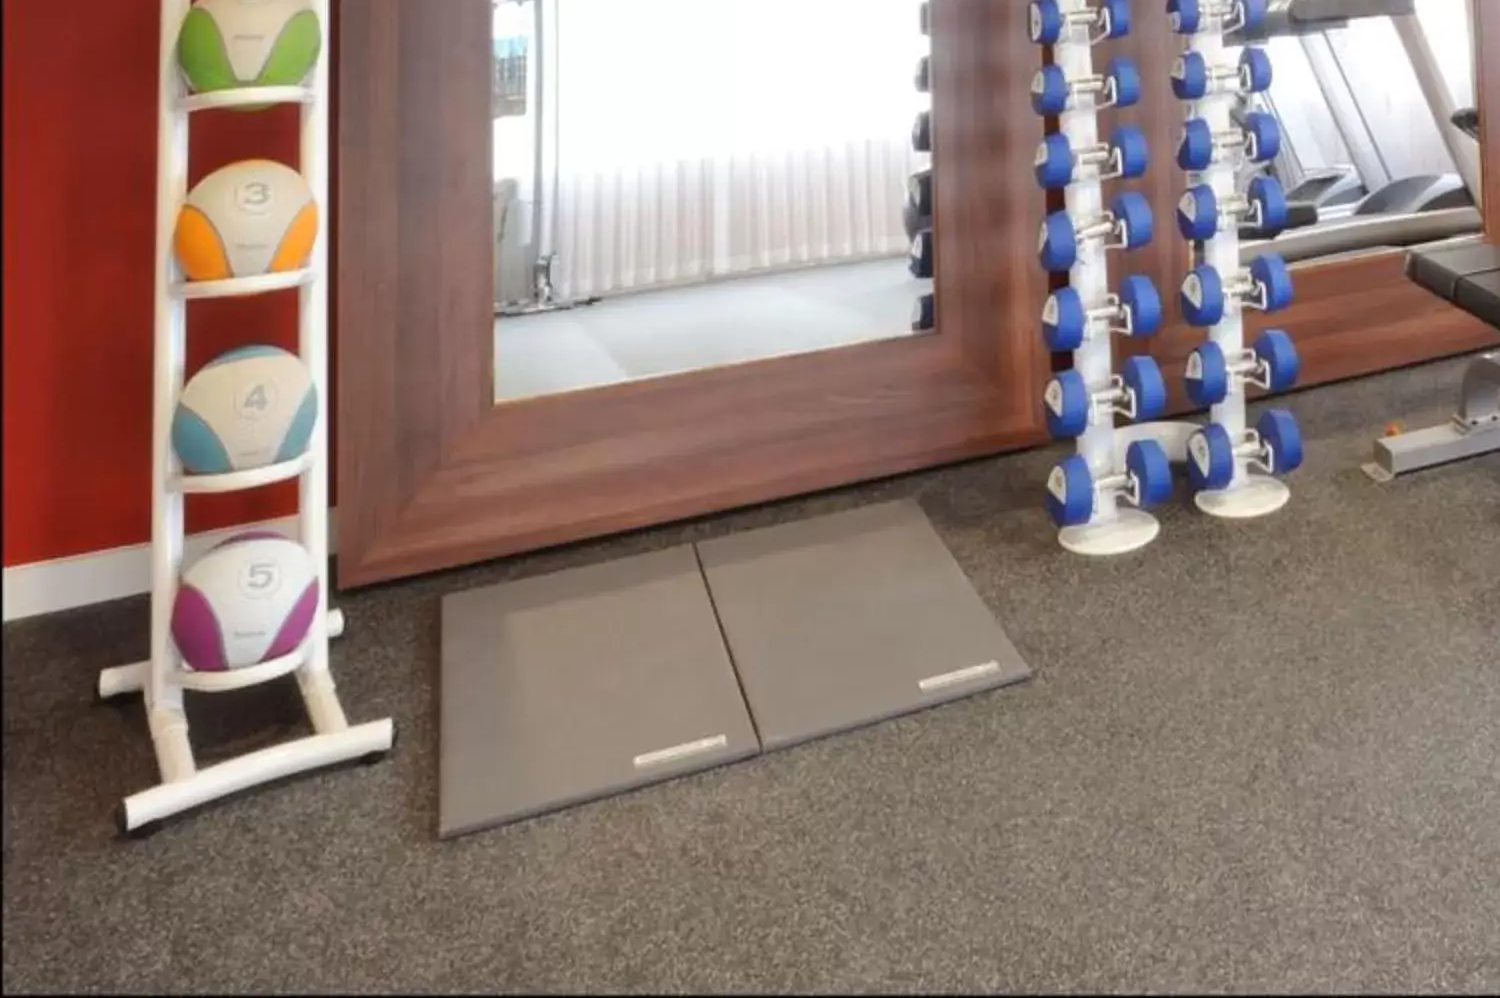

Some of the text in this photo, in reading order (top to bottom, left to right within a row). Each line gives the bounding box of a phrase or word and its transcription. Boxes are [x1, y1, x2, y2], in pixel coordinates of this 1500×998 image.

[244, 182, 270, 205] 3
[244, 384, 268, 411] 4
[248, 563, 275, 589] 5
